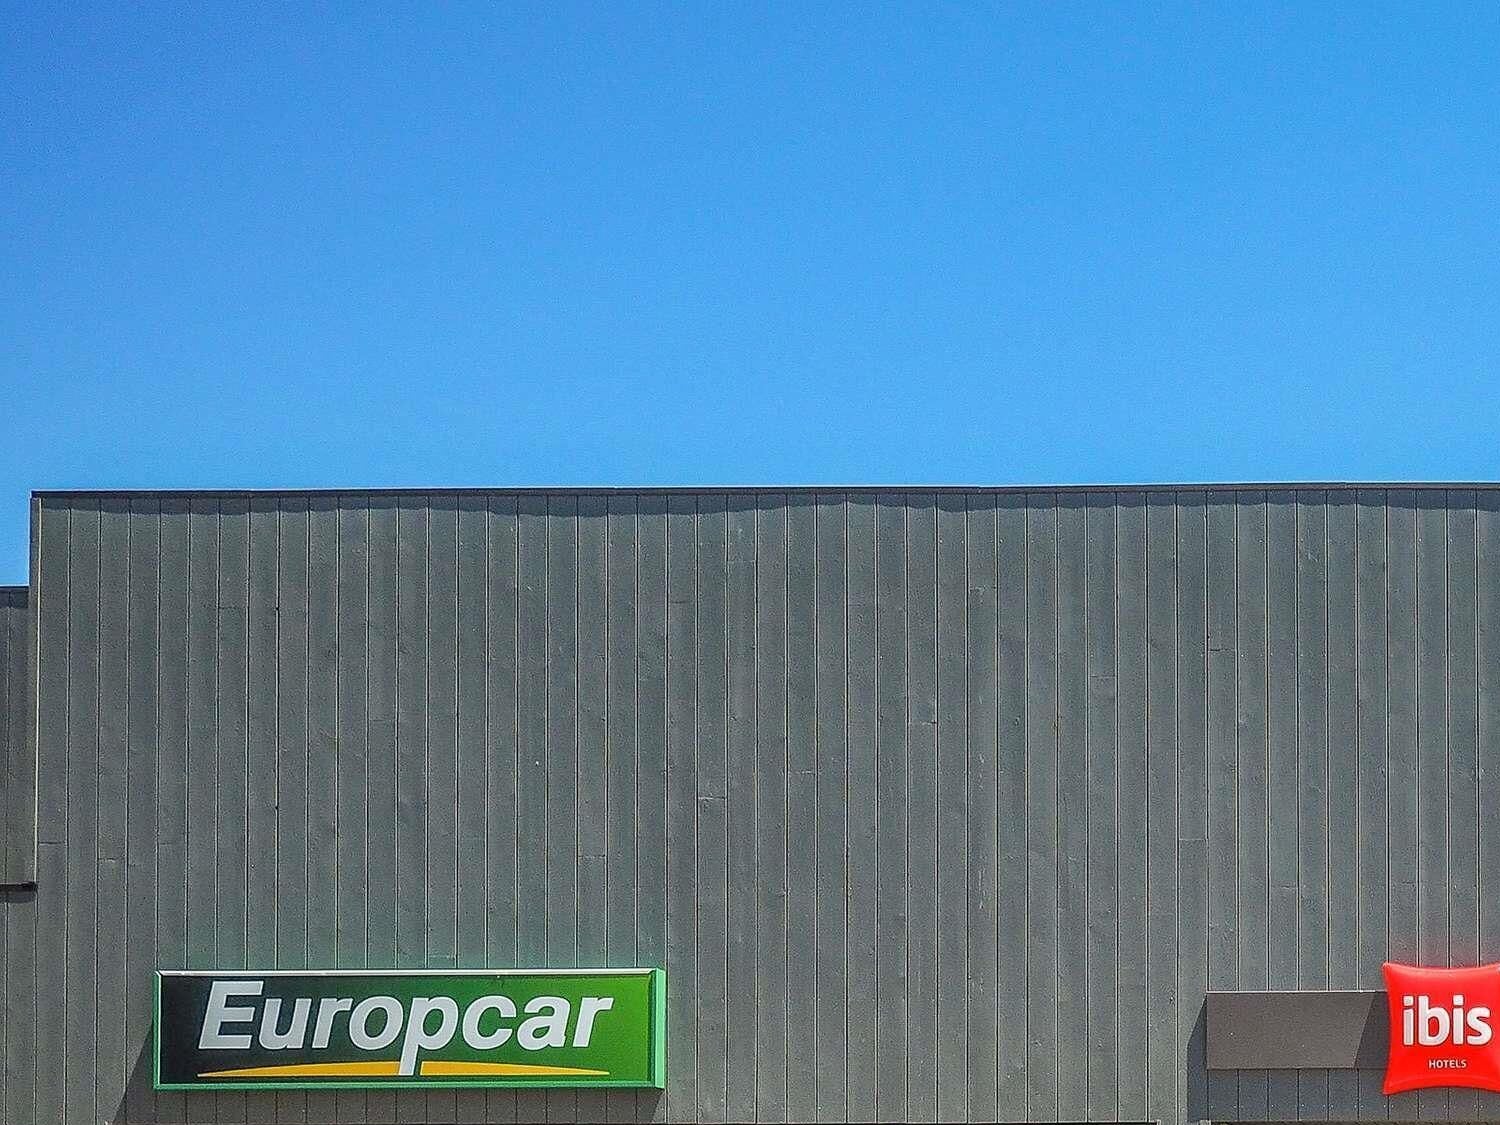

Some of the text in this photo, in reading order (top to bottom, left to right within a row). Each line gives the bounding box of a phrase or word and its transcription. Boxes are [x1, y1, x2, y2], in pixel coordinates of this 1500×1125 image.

[198, 980, 613, 1076] Europcar
[1402, 994, 1493, 1046] ibis
[1428, 1059, 1468, 1070] HOTELS
